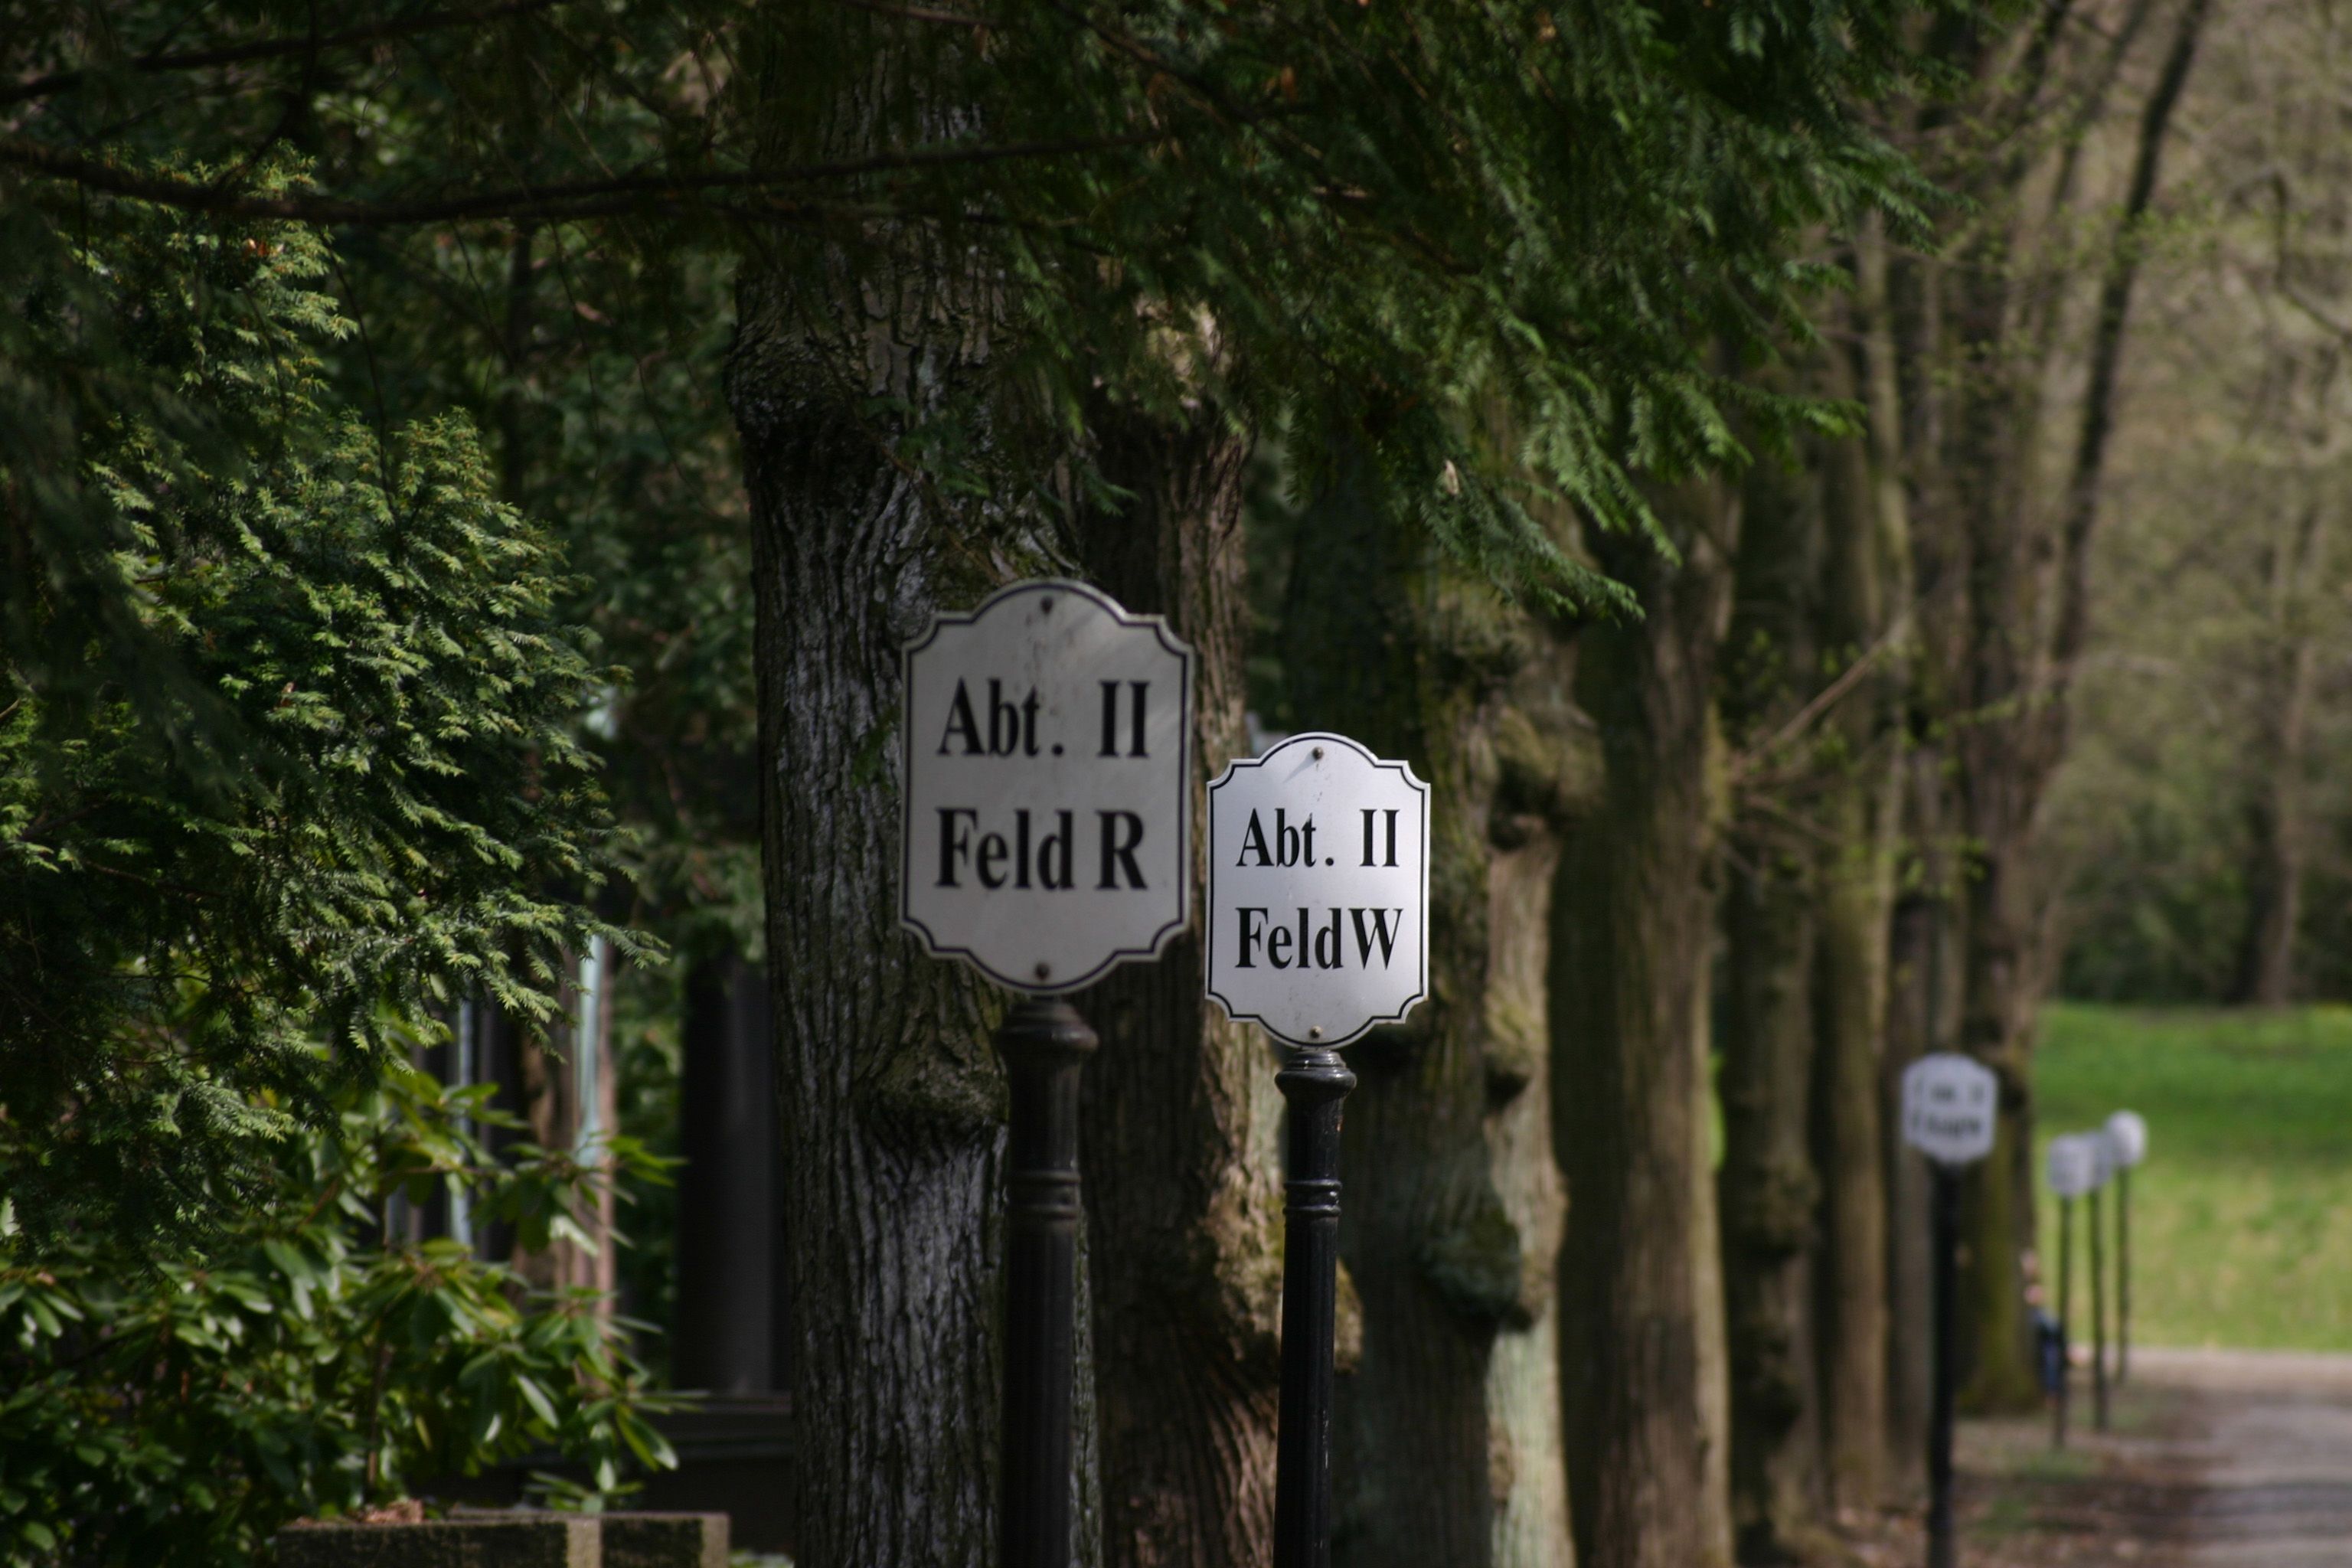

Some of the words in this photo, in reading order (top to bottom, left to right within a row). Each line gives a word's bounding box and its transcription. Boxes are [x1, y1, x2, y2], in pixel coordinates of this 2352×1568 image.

[937, 678, 1064, 757] Abt.
[1099, 681, 1150, 757] II
[935, 808, 1074, 890] Feld
[1096, 811, 1147, 890] R
[1235, 807, 1335, 867] Abt.
[1360, 808, 1400, 867] II
